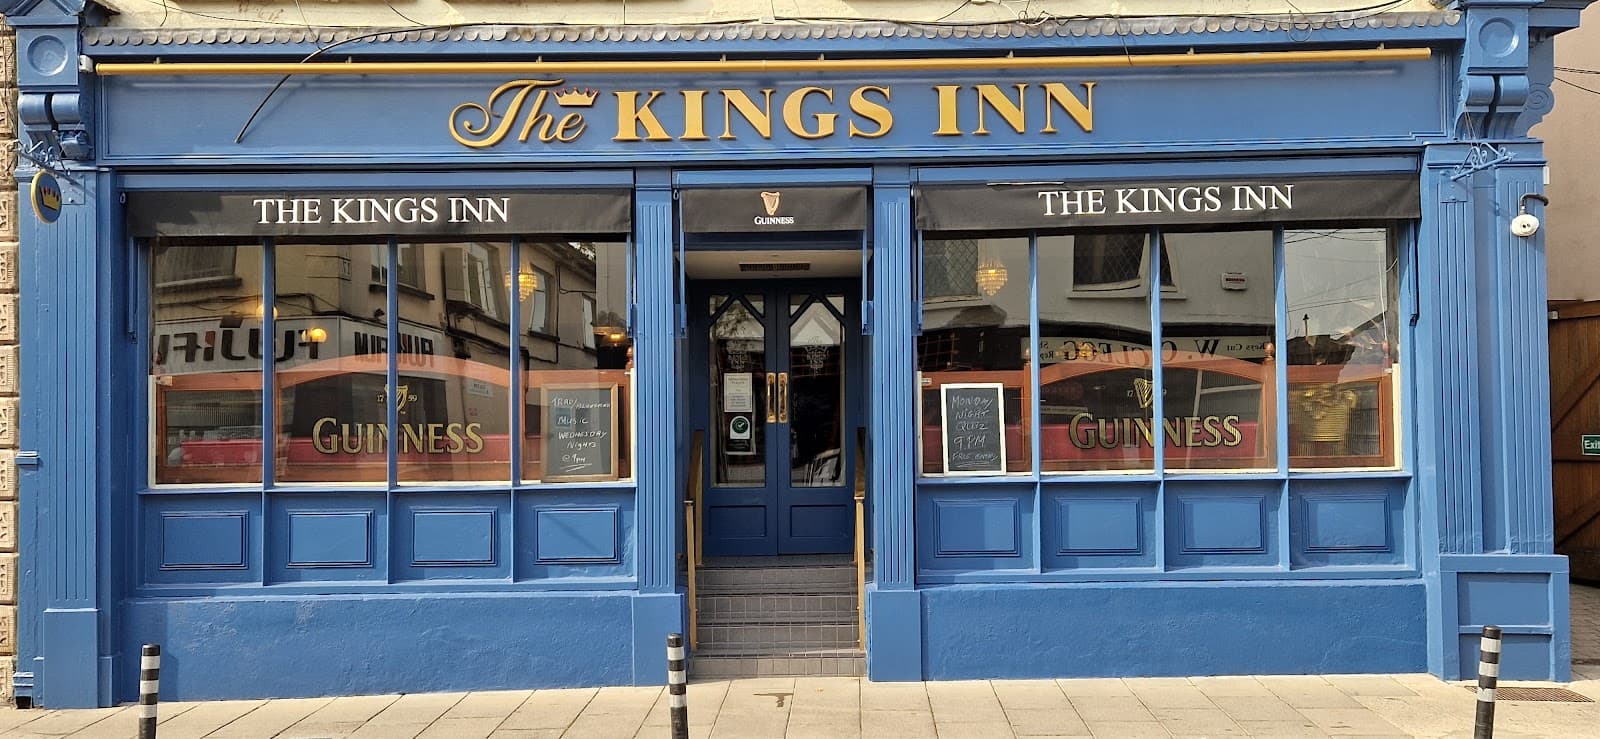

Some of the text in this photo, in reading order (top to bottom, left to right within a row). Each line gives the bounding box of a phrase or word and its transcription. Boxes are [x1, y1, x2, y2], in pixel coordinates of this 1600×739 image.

[449, 78, 1098, 148] The KINGS INN
[253, 196, 510, 224] THE KINGS INN
[1037, 184, 1294, 216] THE KINGS INN
[754, 216, 794, 225] GUINNESS
[951, 394, 993, 410] MONDAY
[312, 417, 484, 454] GUINNESS
[1069, 412, 1242, 449] GUINNESS
